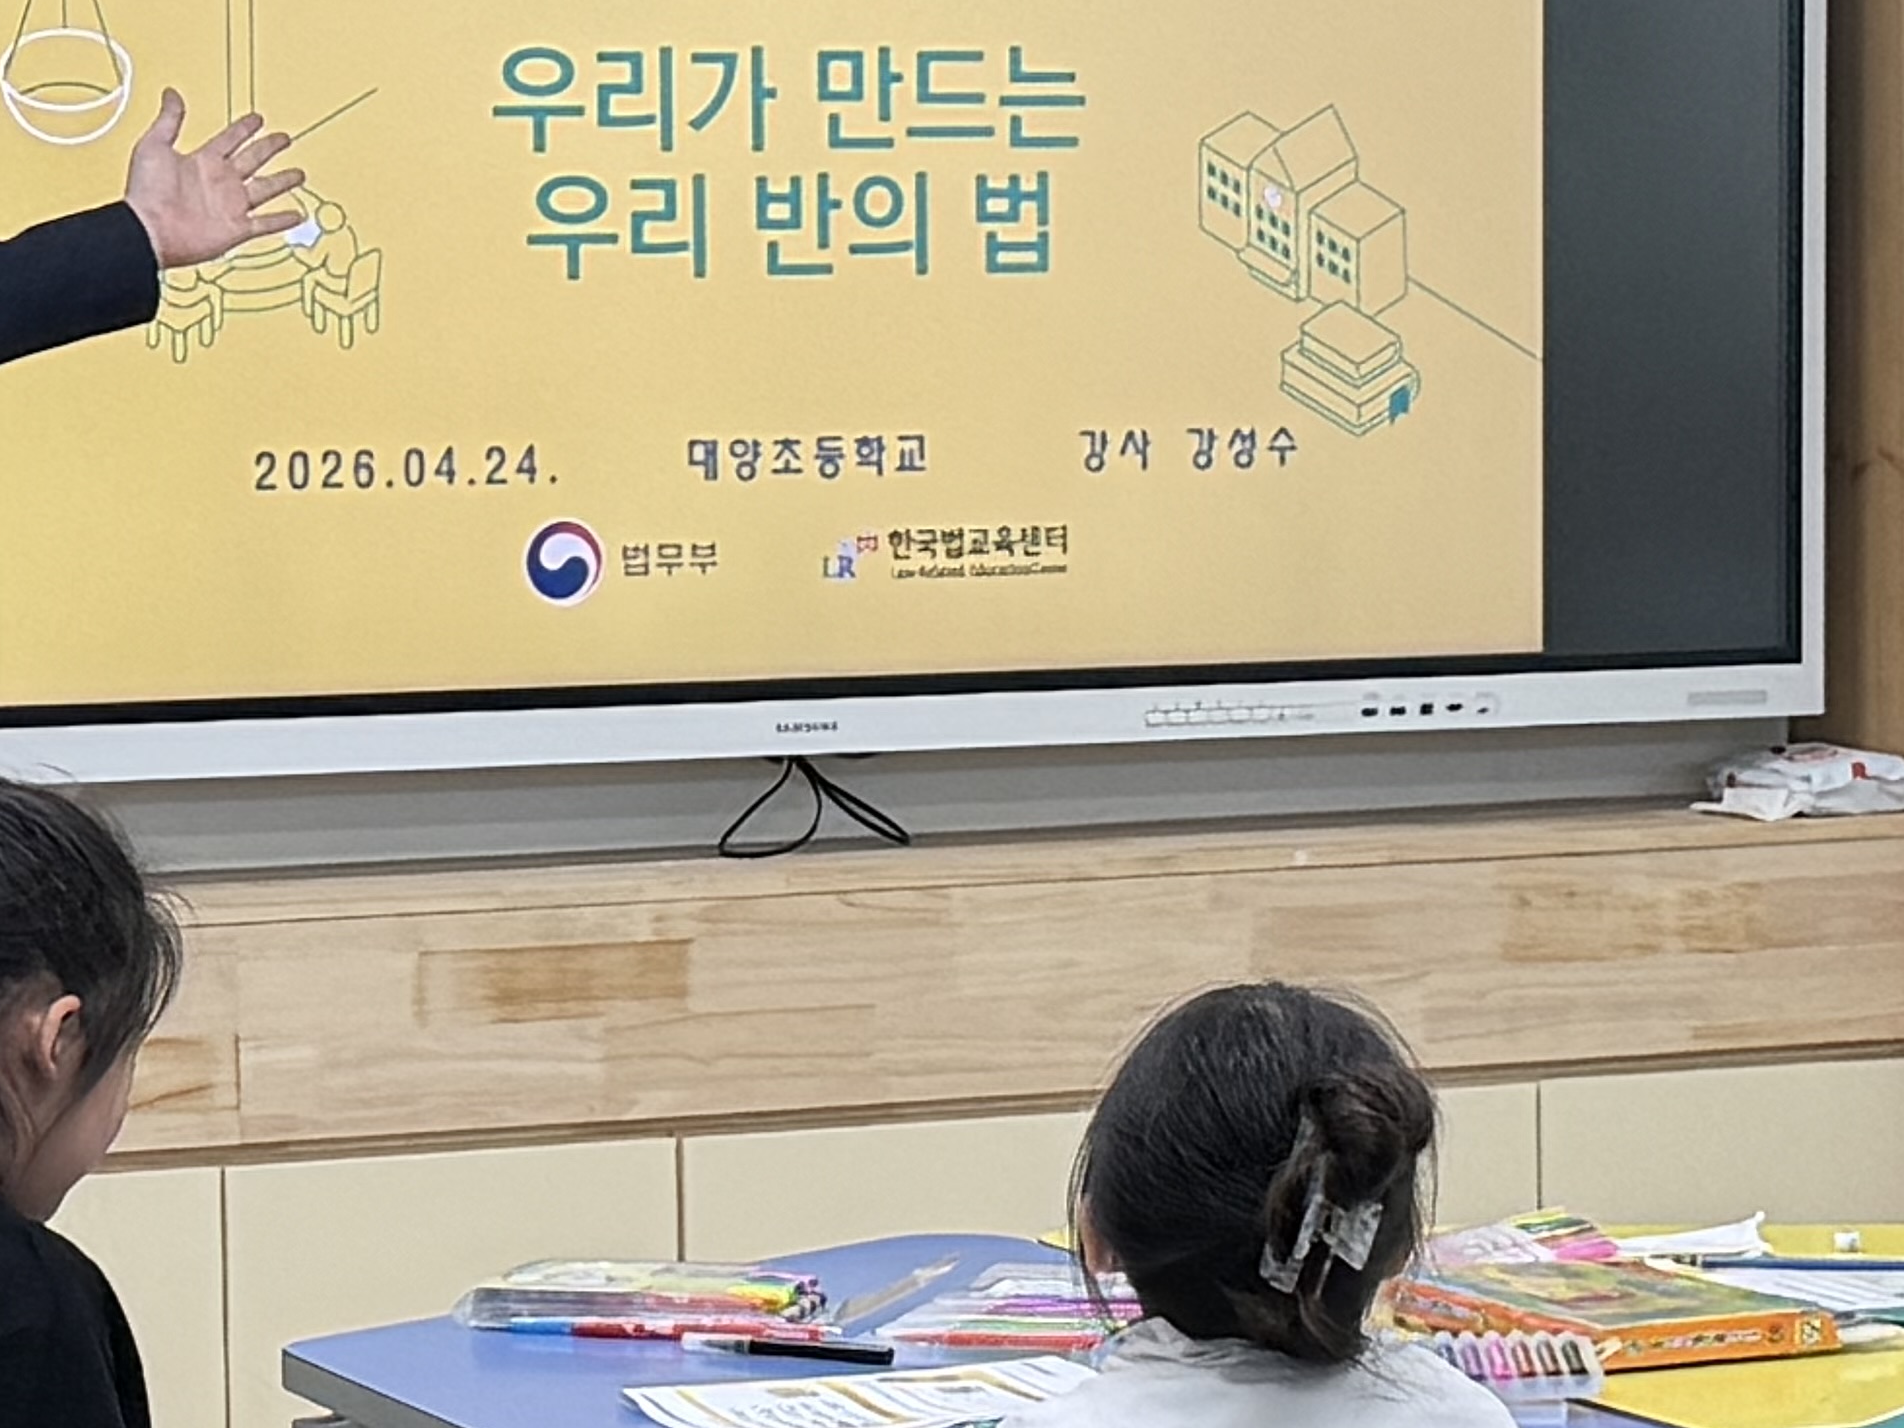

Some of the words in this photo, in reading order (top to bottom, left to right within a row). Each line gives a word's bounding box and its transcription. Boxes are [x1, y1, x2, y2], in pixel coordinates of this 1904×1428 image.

[490, 42, 779, 158] 우리가
[814, 44, 1088, 150] 만드는
[524, 170, 712, 283] 우리
[751, 169, 930, 280] 반의
[971, 169, 1054, 276] 법
[253, 442, 559, 492] 2026.04.24.
[686, 433, 928, 484] 대양초등학교
[1077, 428, 1152, 474] 강사
[1185, 425, 1299, 473] 강성수
[620, 540, 720, 577] 법무부
[887, 523, 1069, 560] 한국법교육센터
